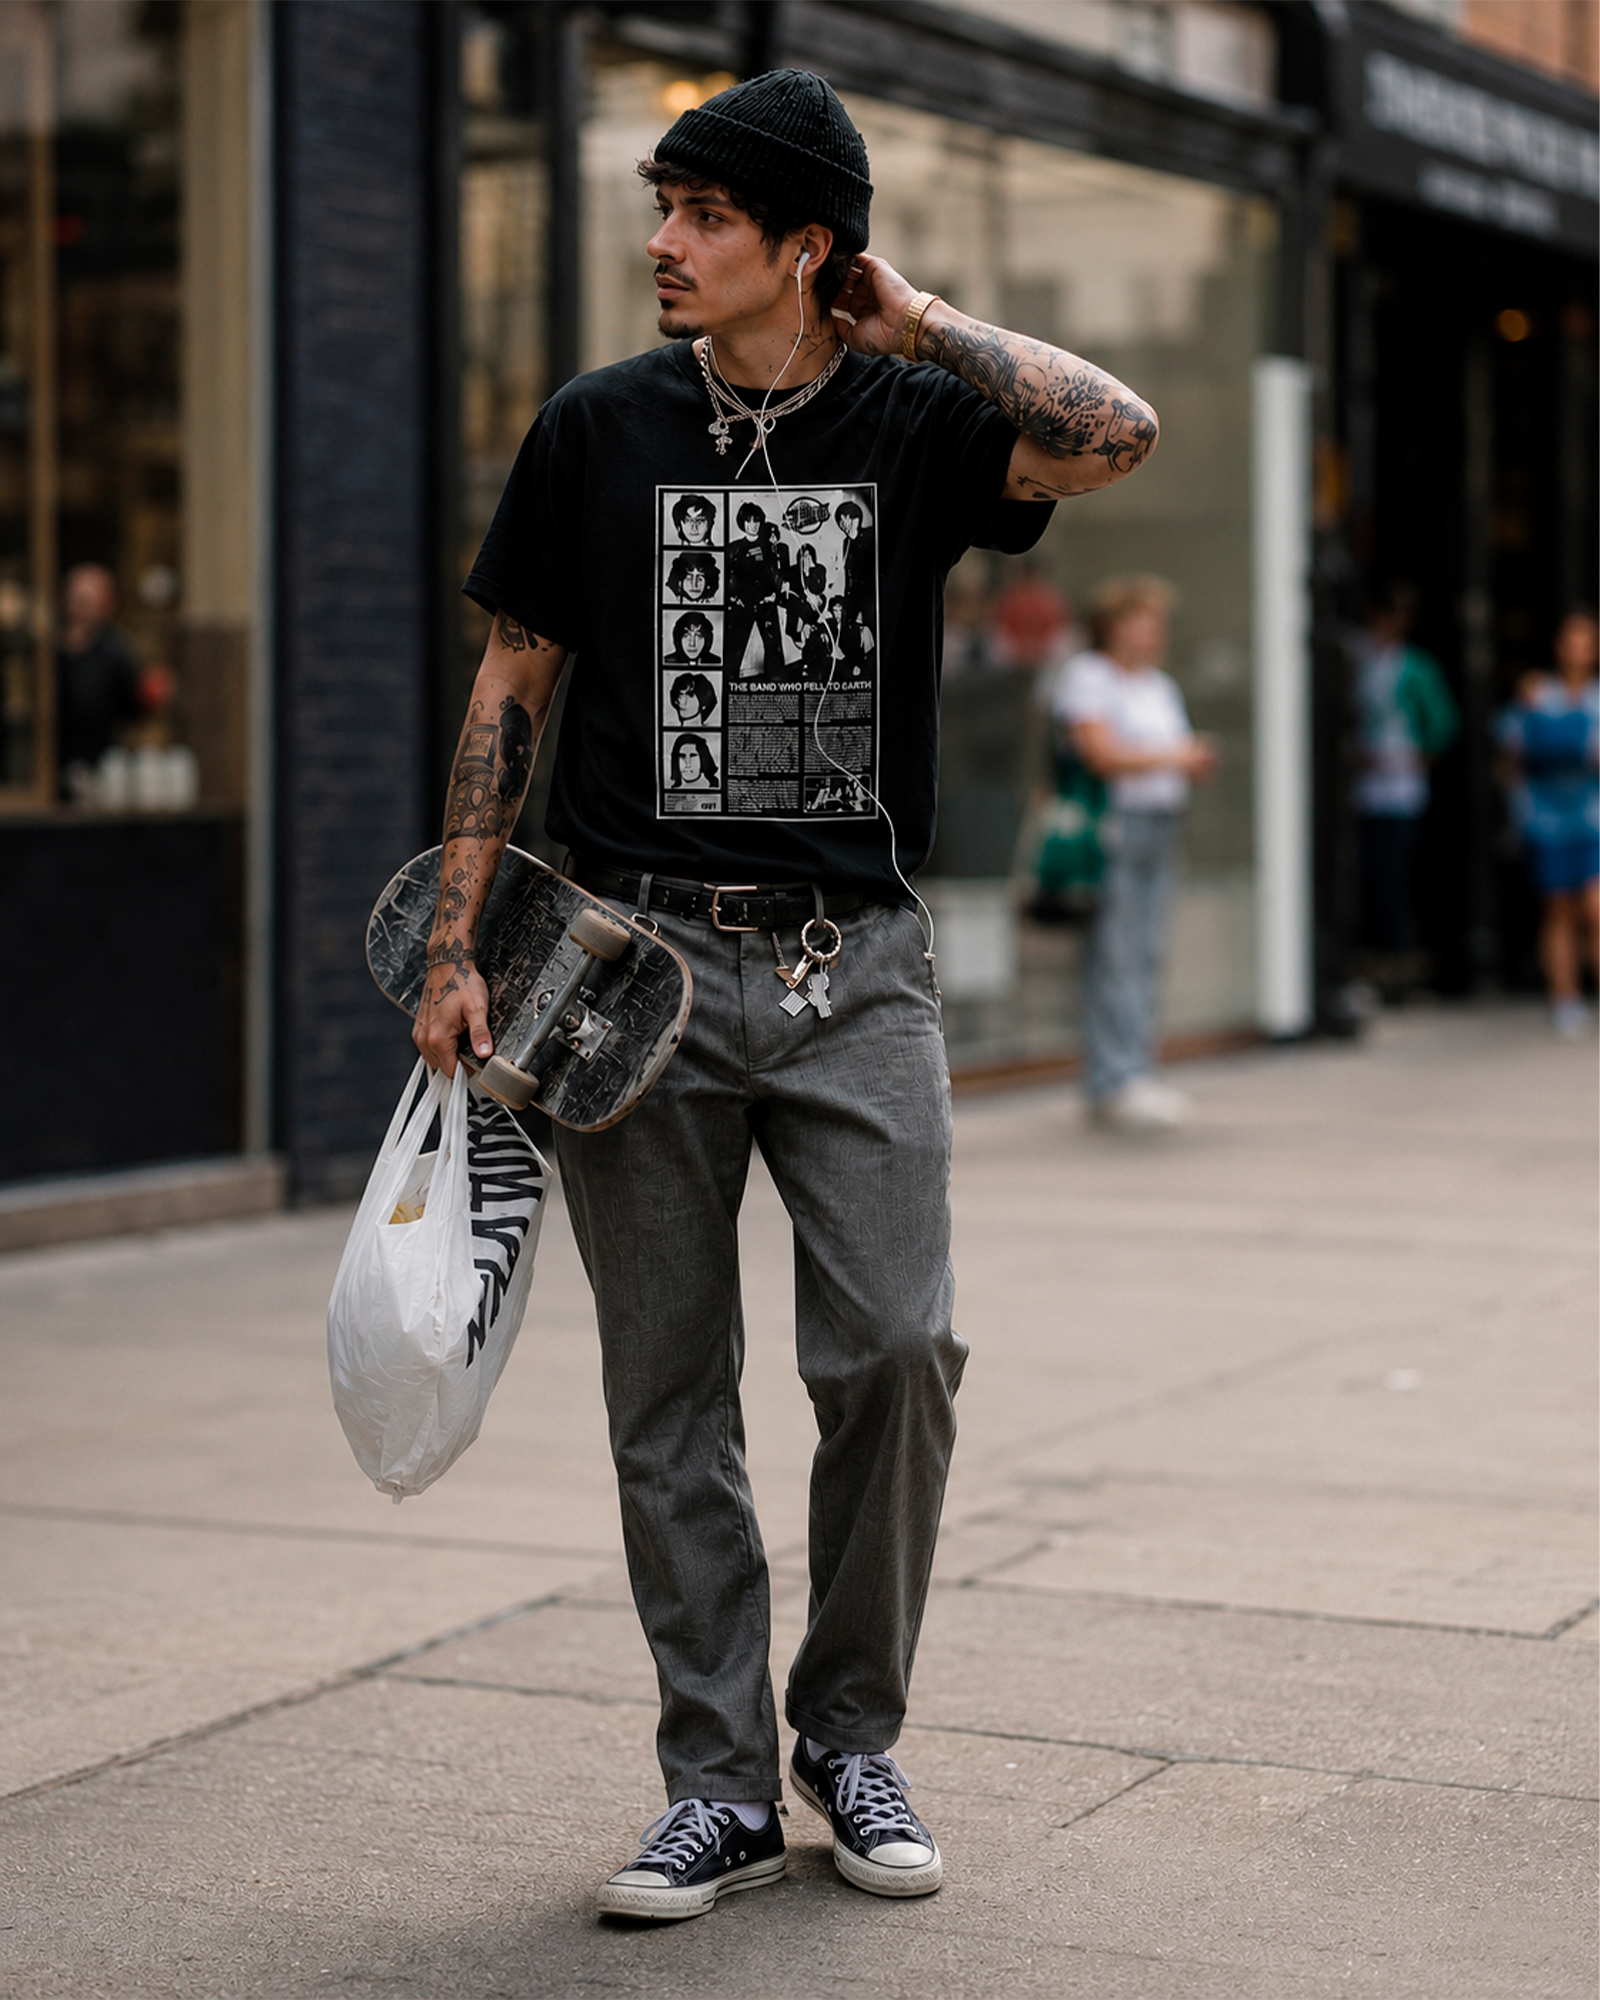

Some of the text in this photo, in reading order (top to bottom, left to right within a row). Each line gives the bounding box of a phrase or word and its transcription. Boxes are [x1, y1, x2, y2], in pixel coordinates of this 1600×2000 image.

[729, 682, 748, 692] THE
[778, 682, 802, 692] WHO
[803, 682, 825, 692] FELL
[828, 681, 841, 691] TO
